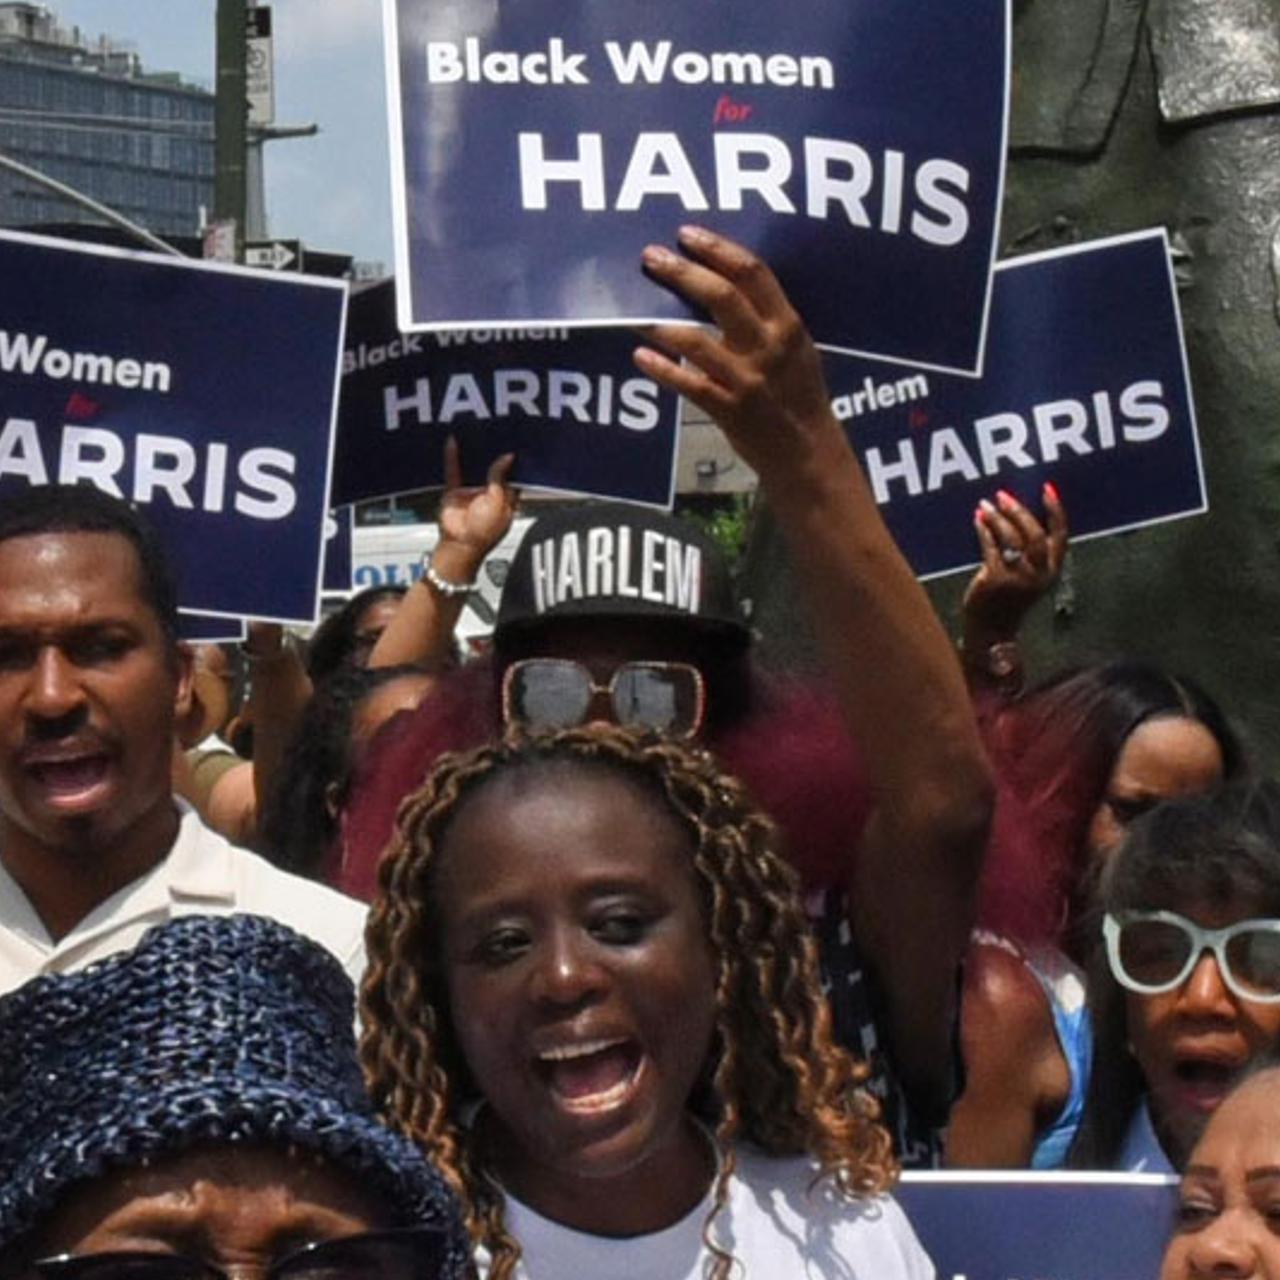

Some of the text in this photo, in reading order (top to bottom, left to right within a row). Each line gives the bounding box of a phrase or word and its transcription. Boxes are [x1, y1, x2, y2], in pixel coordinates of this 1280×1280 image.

[426, 36, 835, 90] Black Women
[712, 94, 753, 127] for
[520, 131, 970, 247] HARRIS
[342, 333, 423, 374] Black
[383, 369, 660, 433] HARRIS
[831, 373, 930, 421] arlem
[865, 380, 1170, 504] HARRIS
[532, 525, 702, 615] HARLEM
